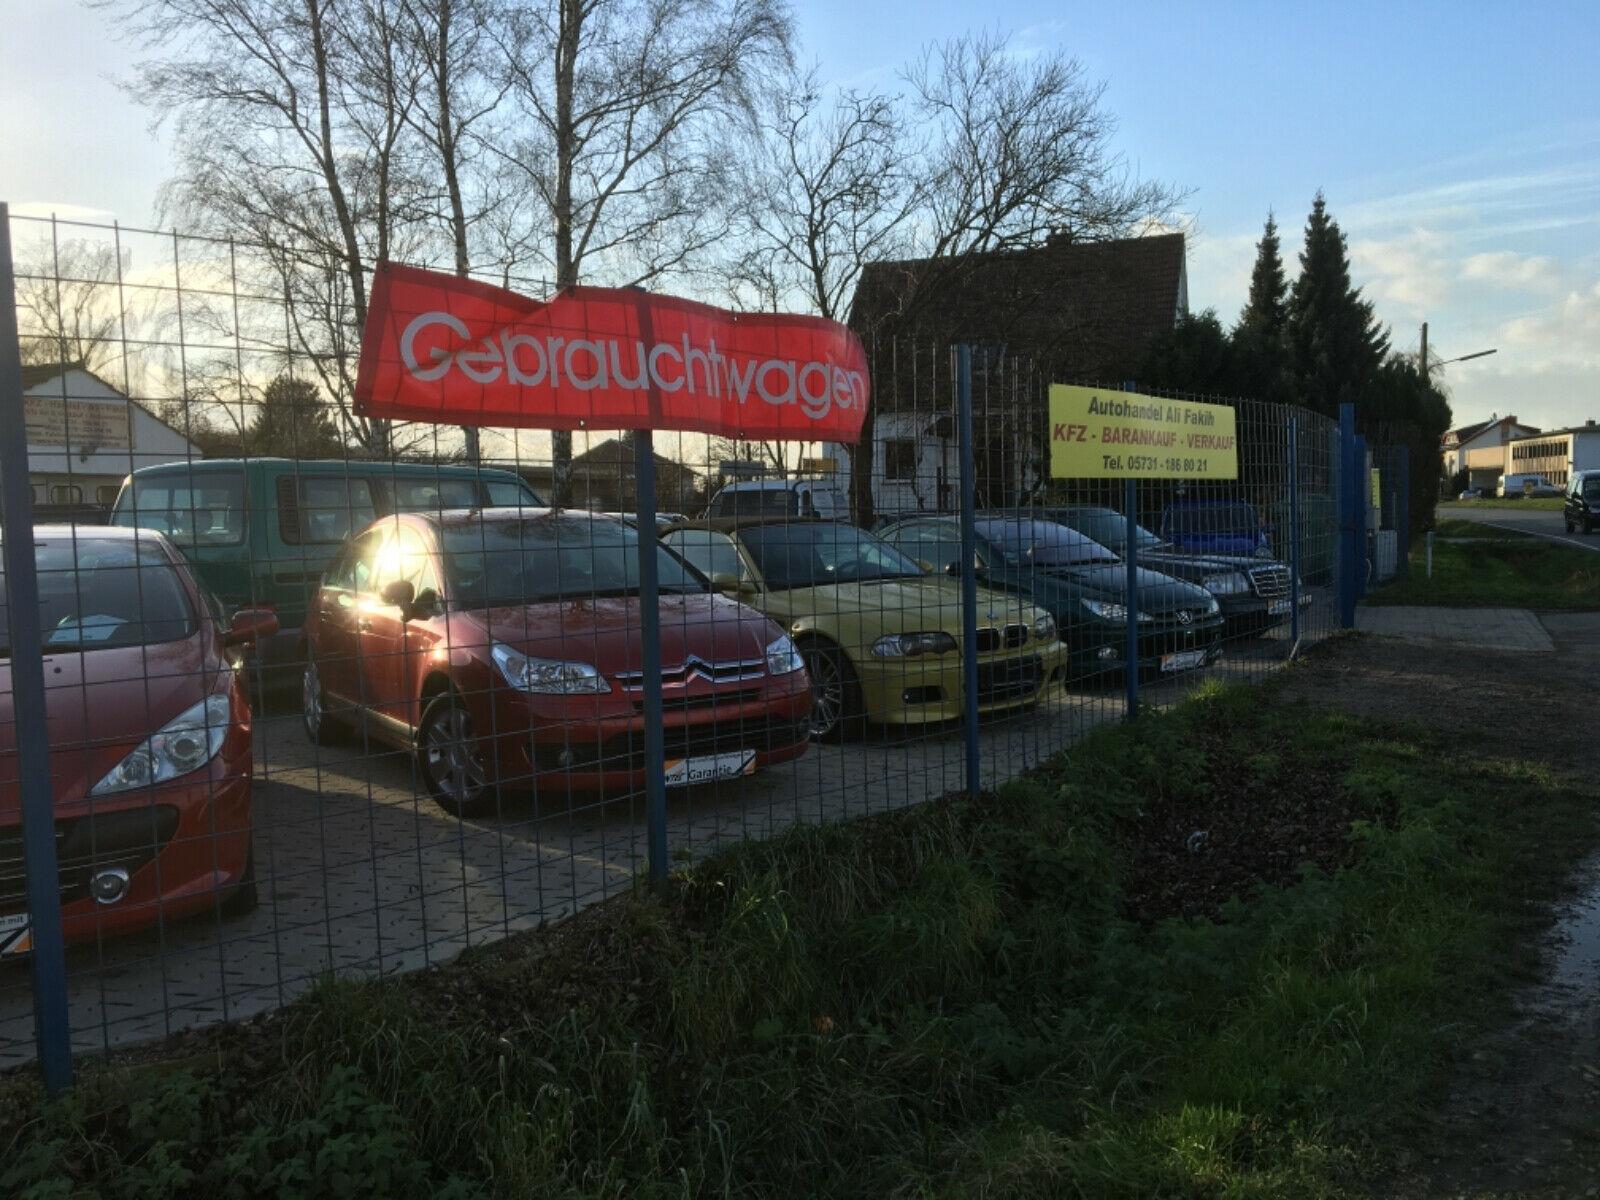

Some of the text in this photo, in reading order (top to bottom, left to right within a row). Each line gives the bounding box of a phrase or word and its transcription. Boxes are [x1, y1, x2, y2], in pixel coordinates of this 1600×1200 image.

[401, 311, 866, 419] Gebrauchtwagen
[1088, 396, 1215, 426] Autohandel Ali Fakih
[1053, 424, 1088, 442] KFZ
[1102, 426, 1177, 447] BARANKAUF
[1187, 433, 1235, 450] VERKAUF
[1103, 455, 1123, 470] Tel.
[1127, 456, 1157, 471] 05731
[1196, 459, 1208, 472] 21
[689, 765, 733, 780] Garantie
